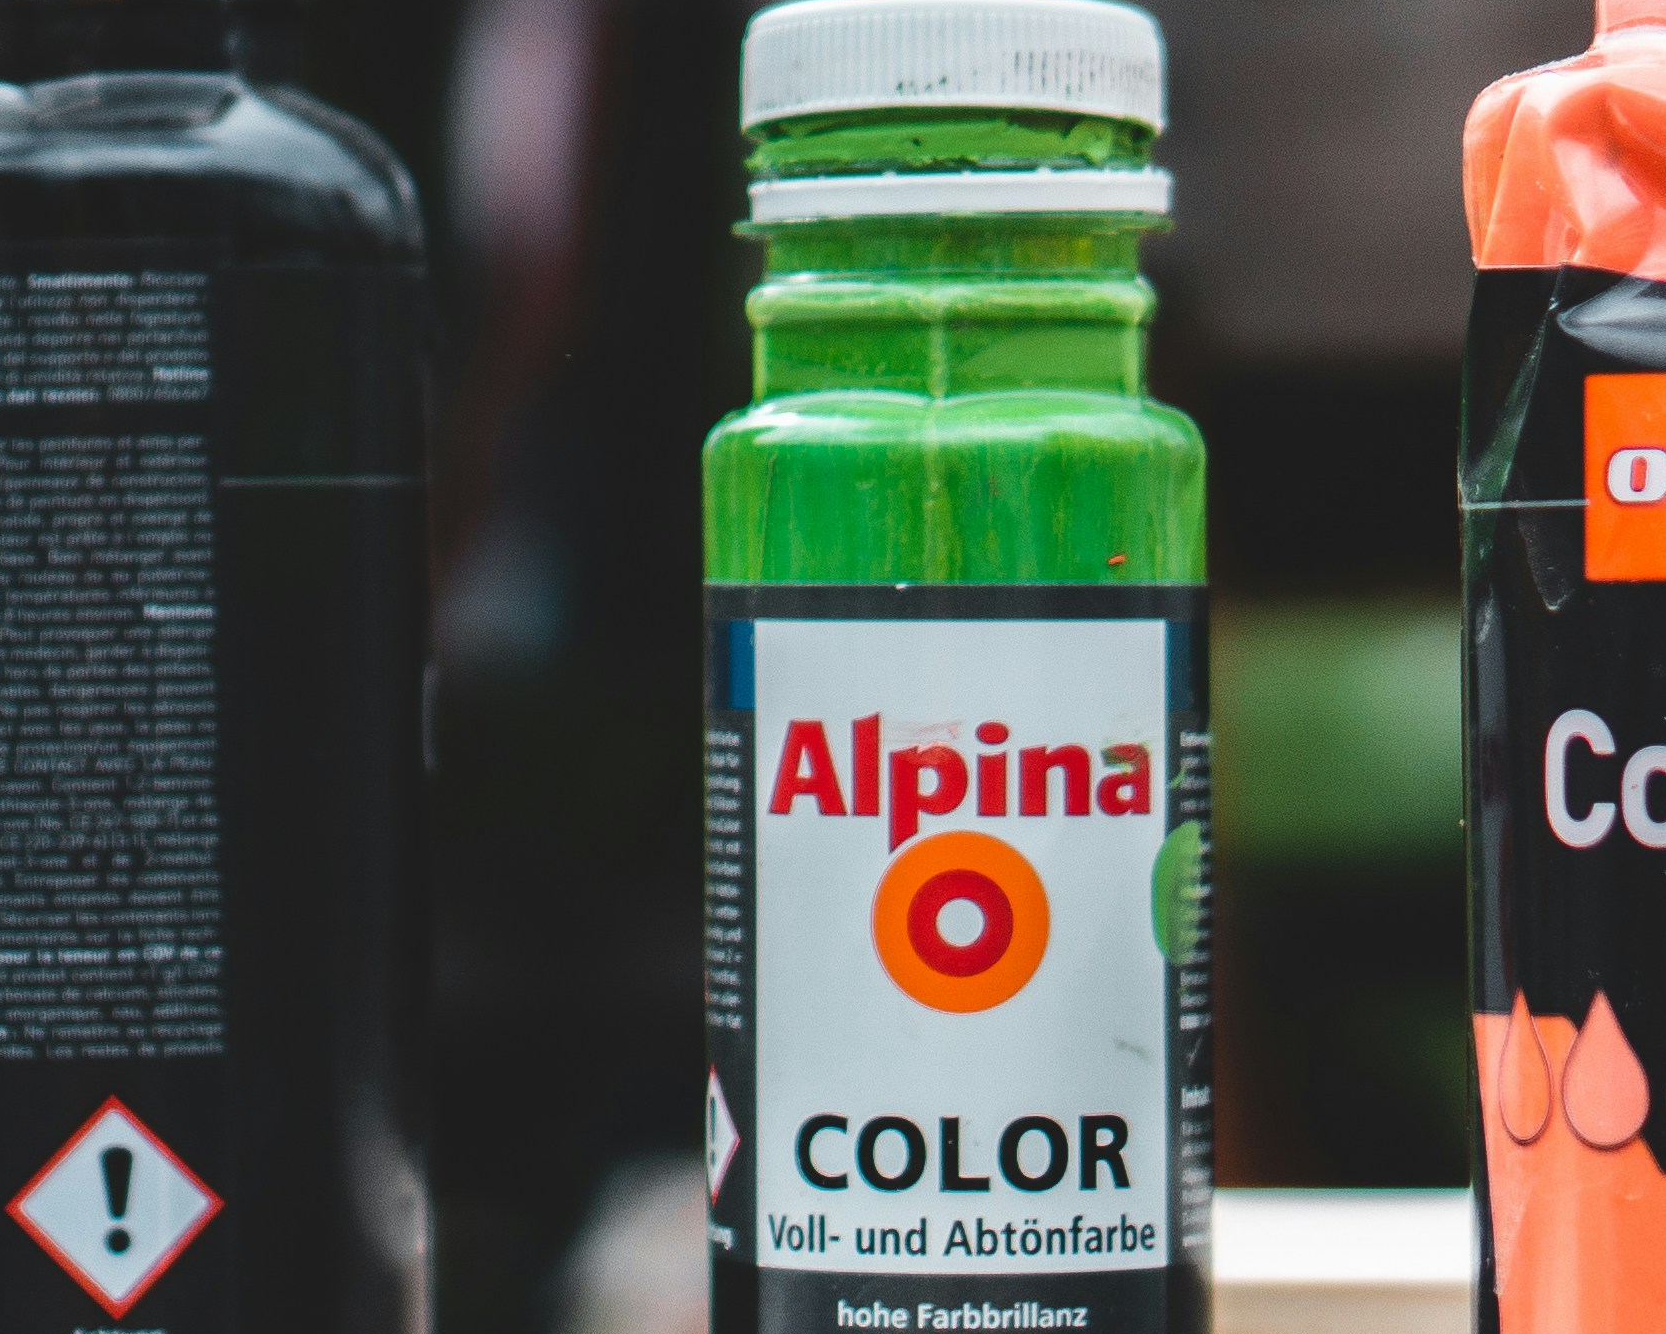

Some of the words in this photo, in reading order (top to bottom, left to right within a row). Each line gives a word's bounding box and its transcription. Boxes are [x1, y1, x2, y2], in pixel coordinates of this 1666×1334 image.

[768, 712, 1152, 856] Alpina
[794, 1113, 1131, 1193] COLOR
[768, 1214, 841, 1253] Voll-
[856, 1218, 927, 1256] und
[943, 1214, 1156, 1257] Abtönfarbe
[837, 1300, 909, 1329] hohe
[917, 1301, 1088, 1330] Farbbrillanz
